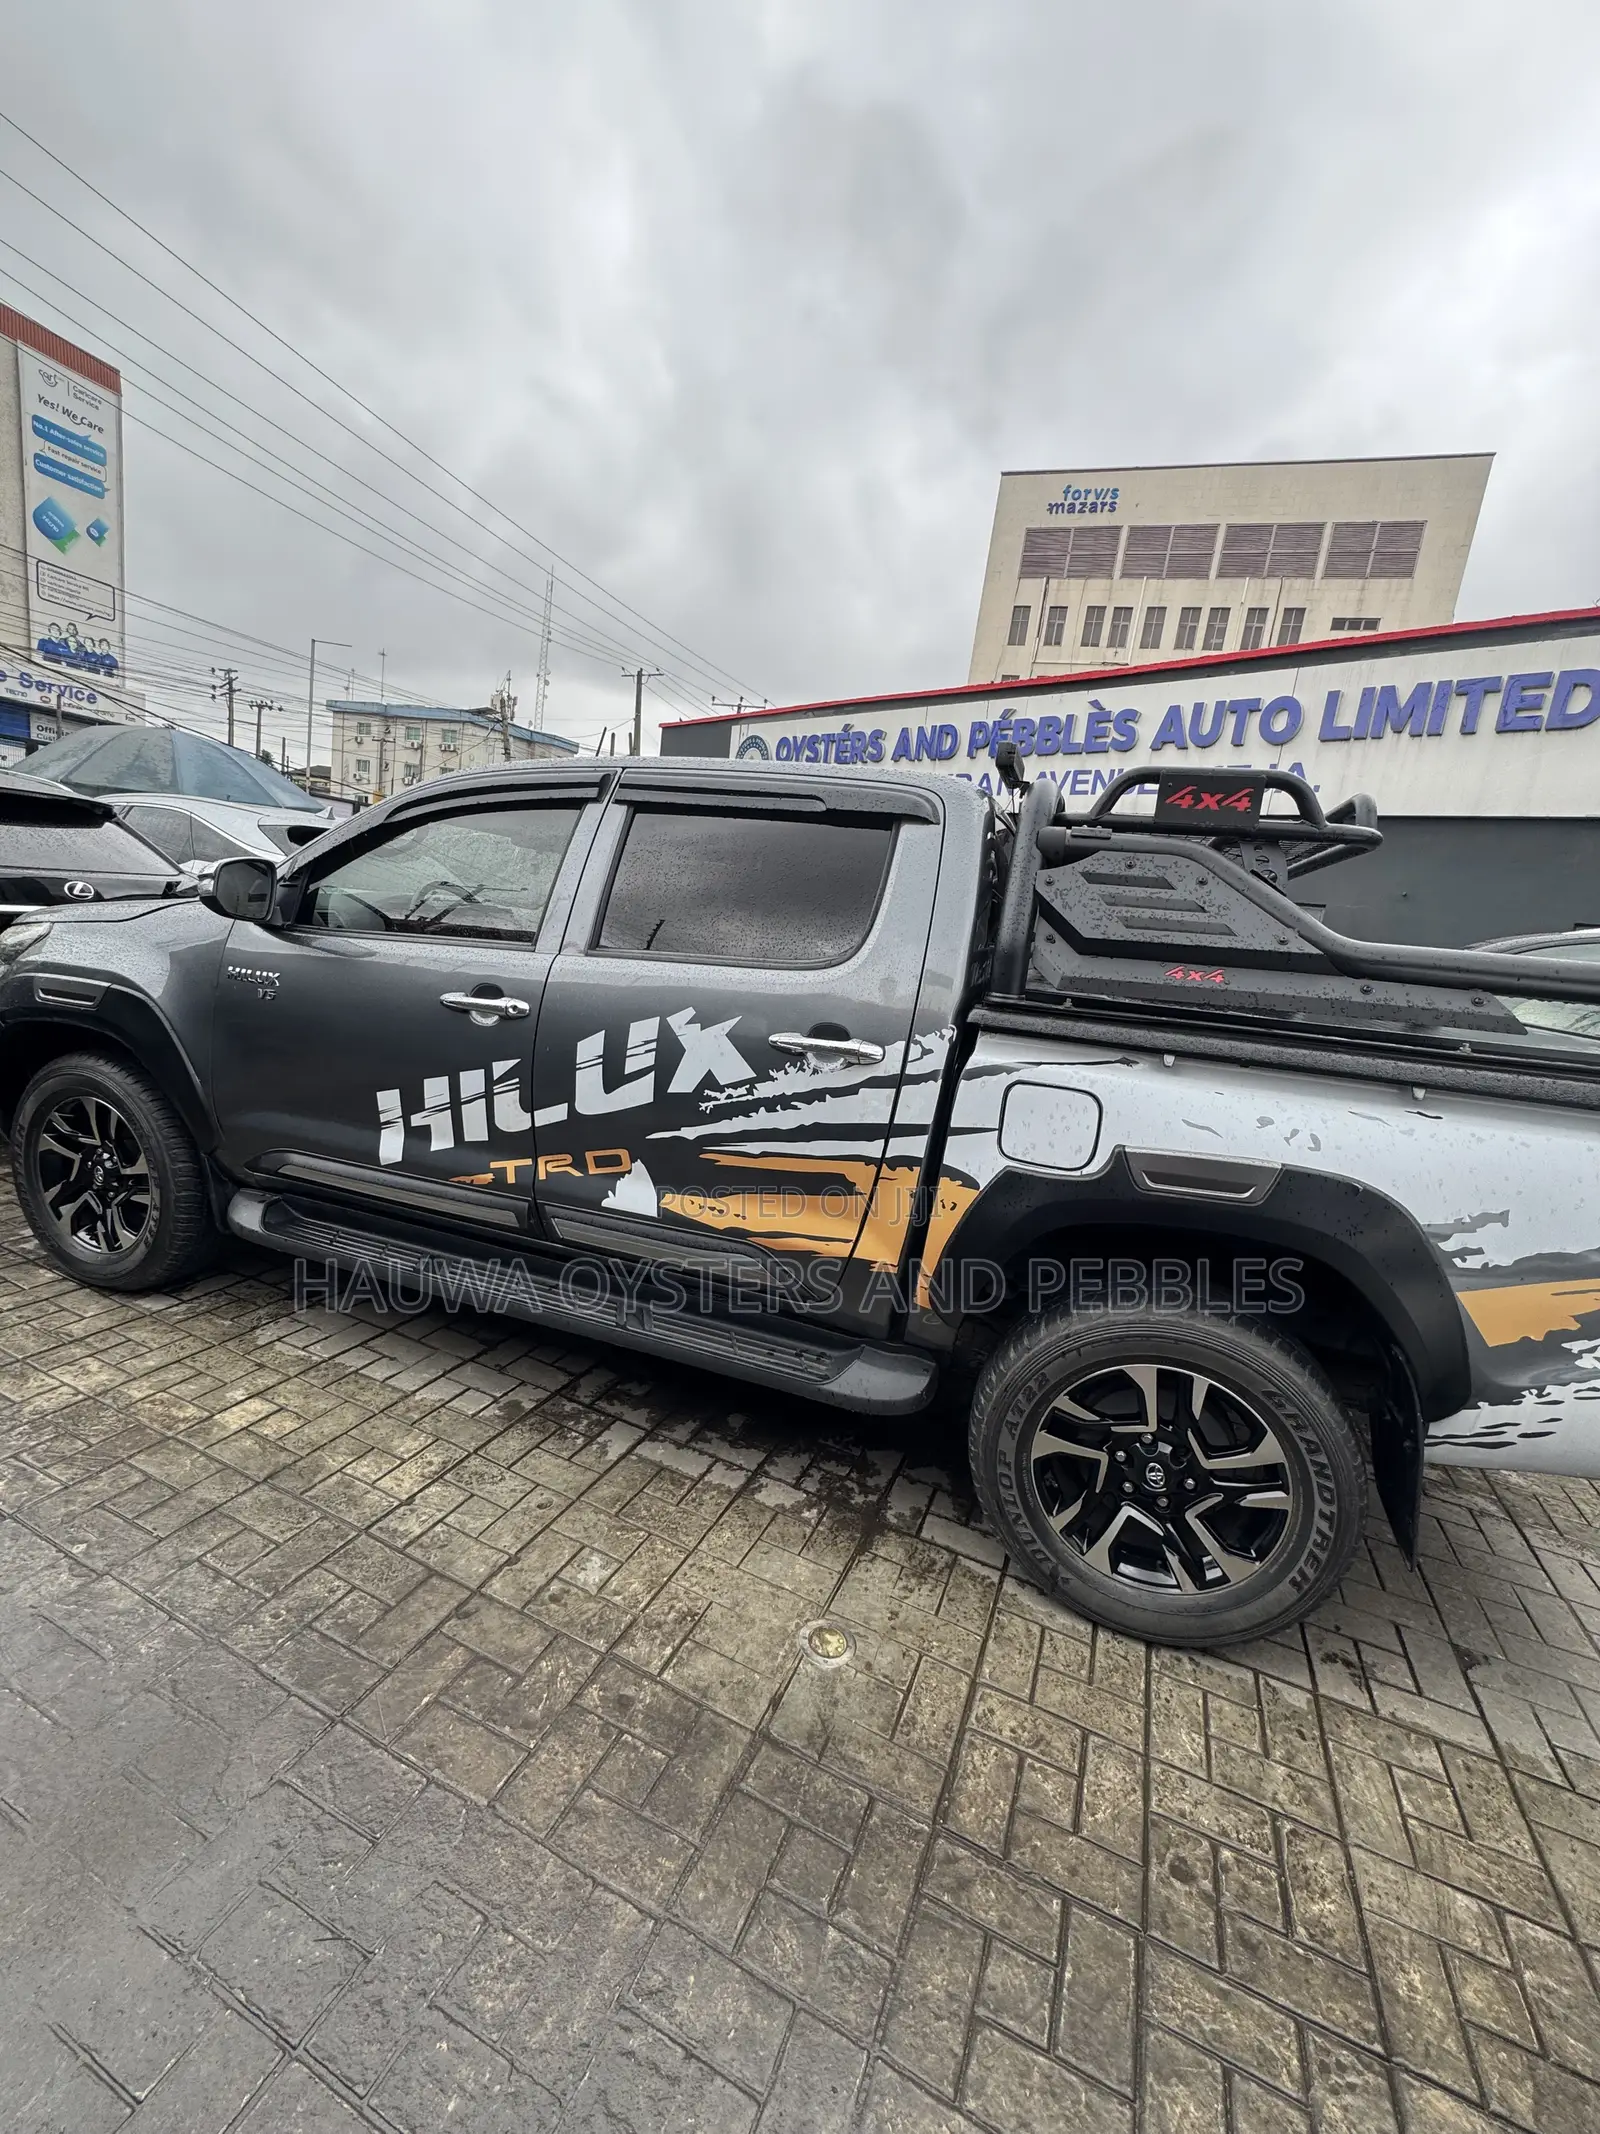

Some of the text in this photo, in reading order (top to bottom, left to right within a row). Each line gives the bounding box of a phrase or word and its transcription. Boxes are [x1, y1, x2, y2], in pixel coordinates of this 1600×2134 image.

[37, 393, 104, 434] Yes! We Care
[72, 392, 99, 411] Service
[47, 446, 102, 475] Fast repair service
[83, 444, 105, 459] service
[35, 459, 103, 493] Customer satisfaction
[1063, 484, 1120, 501] forvis
[1047, 500, 1118, 515] mazars
[19, 671, 98, 704] Service
[891, 724, 962, 762] AND
[1150, 695, 1305, 752] AUTO
[1318, 668, 1600, 742] LIMITED
[1165, 786, 1254, 812] 4x4
[227, 966, 280, 986] HILUX
[1164, 966, 1225, 984] 4x4
[376, 1006, 757, 1166] HILUX
[490, 1148, 632, 1184] TRD
[999, 1448, 1050, 1563] DUNLOP
